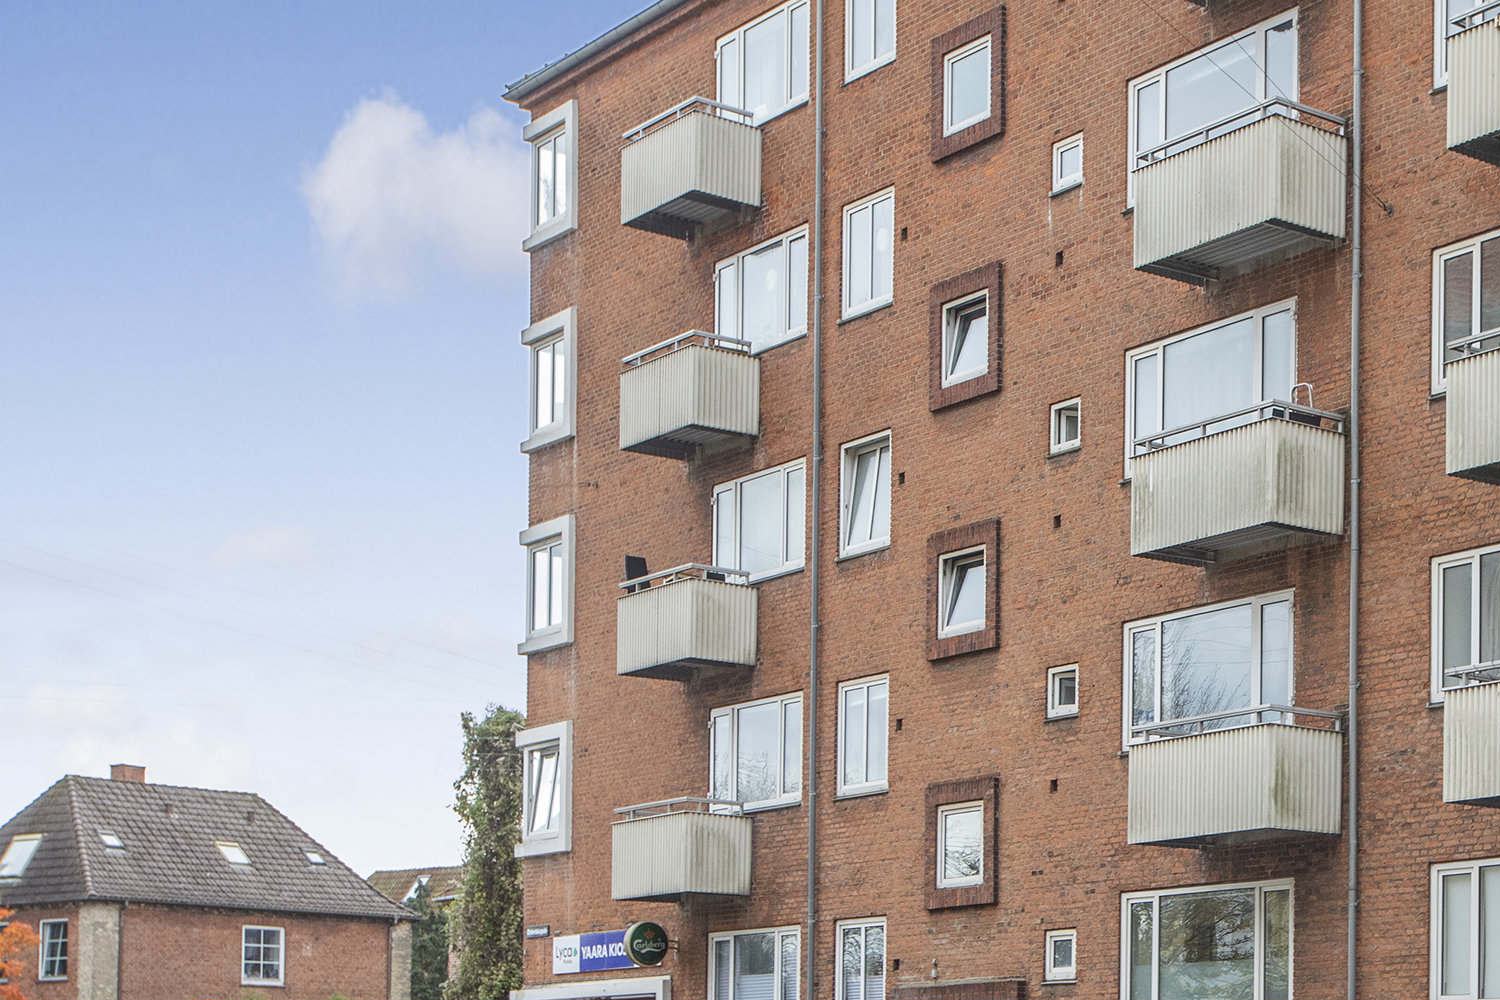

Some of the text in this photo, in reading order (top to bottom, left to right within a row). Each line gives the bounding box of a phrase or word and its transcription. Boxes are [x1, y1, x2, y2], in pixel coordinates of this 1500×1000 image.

[581, 942, 627, 960] YAARA KIO
[633, 938, 666, 953] Carlsberg
